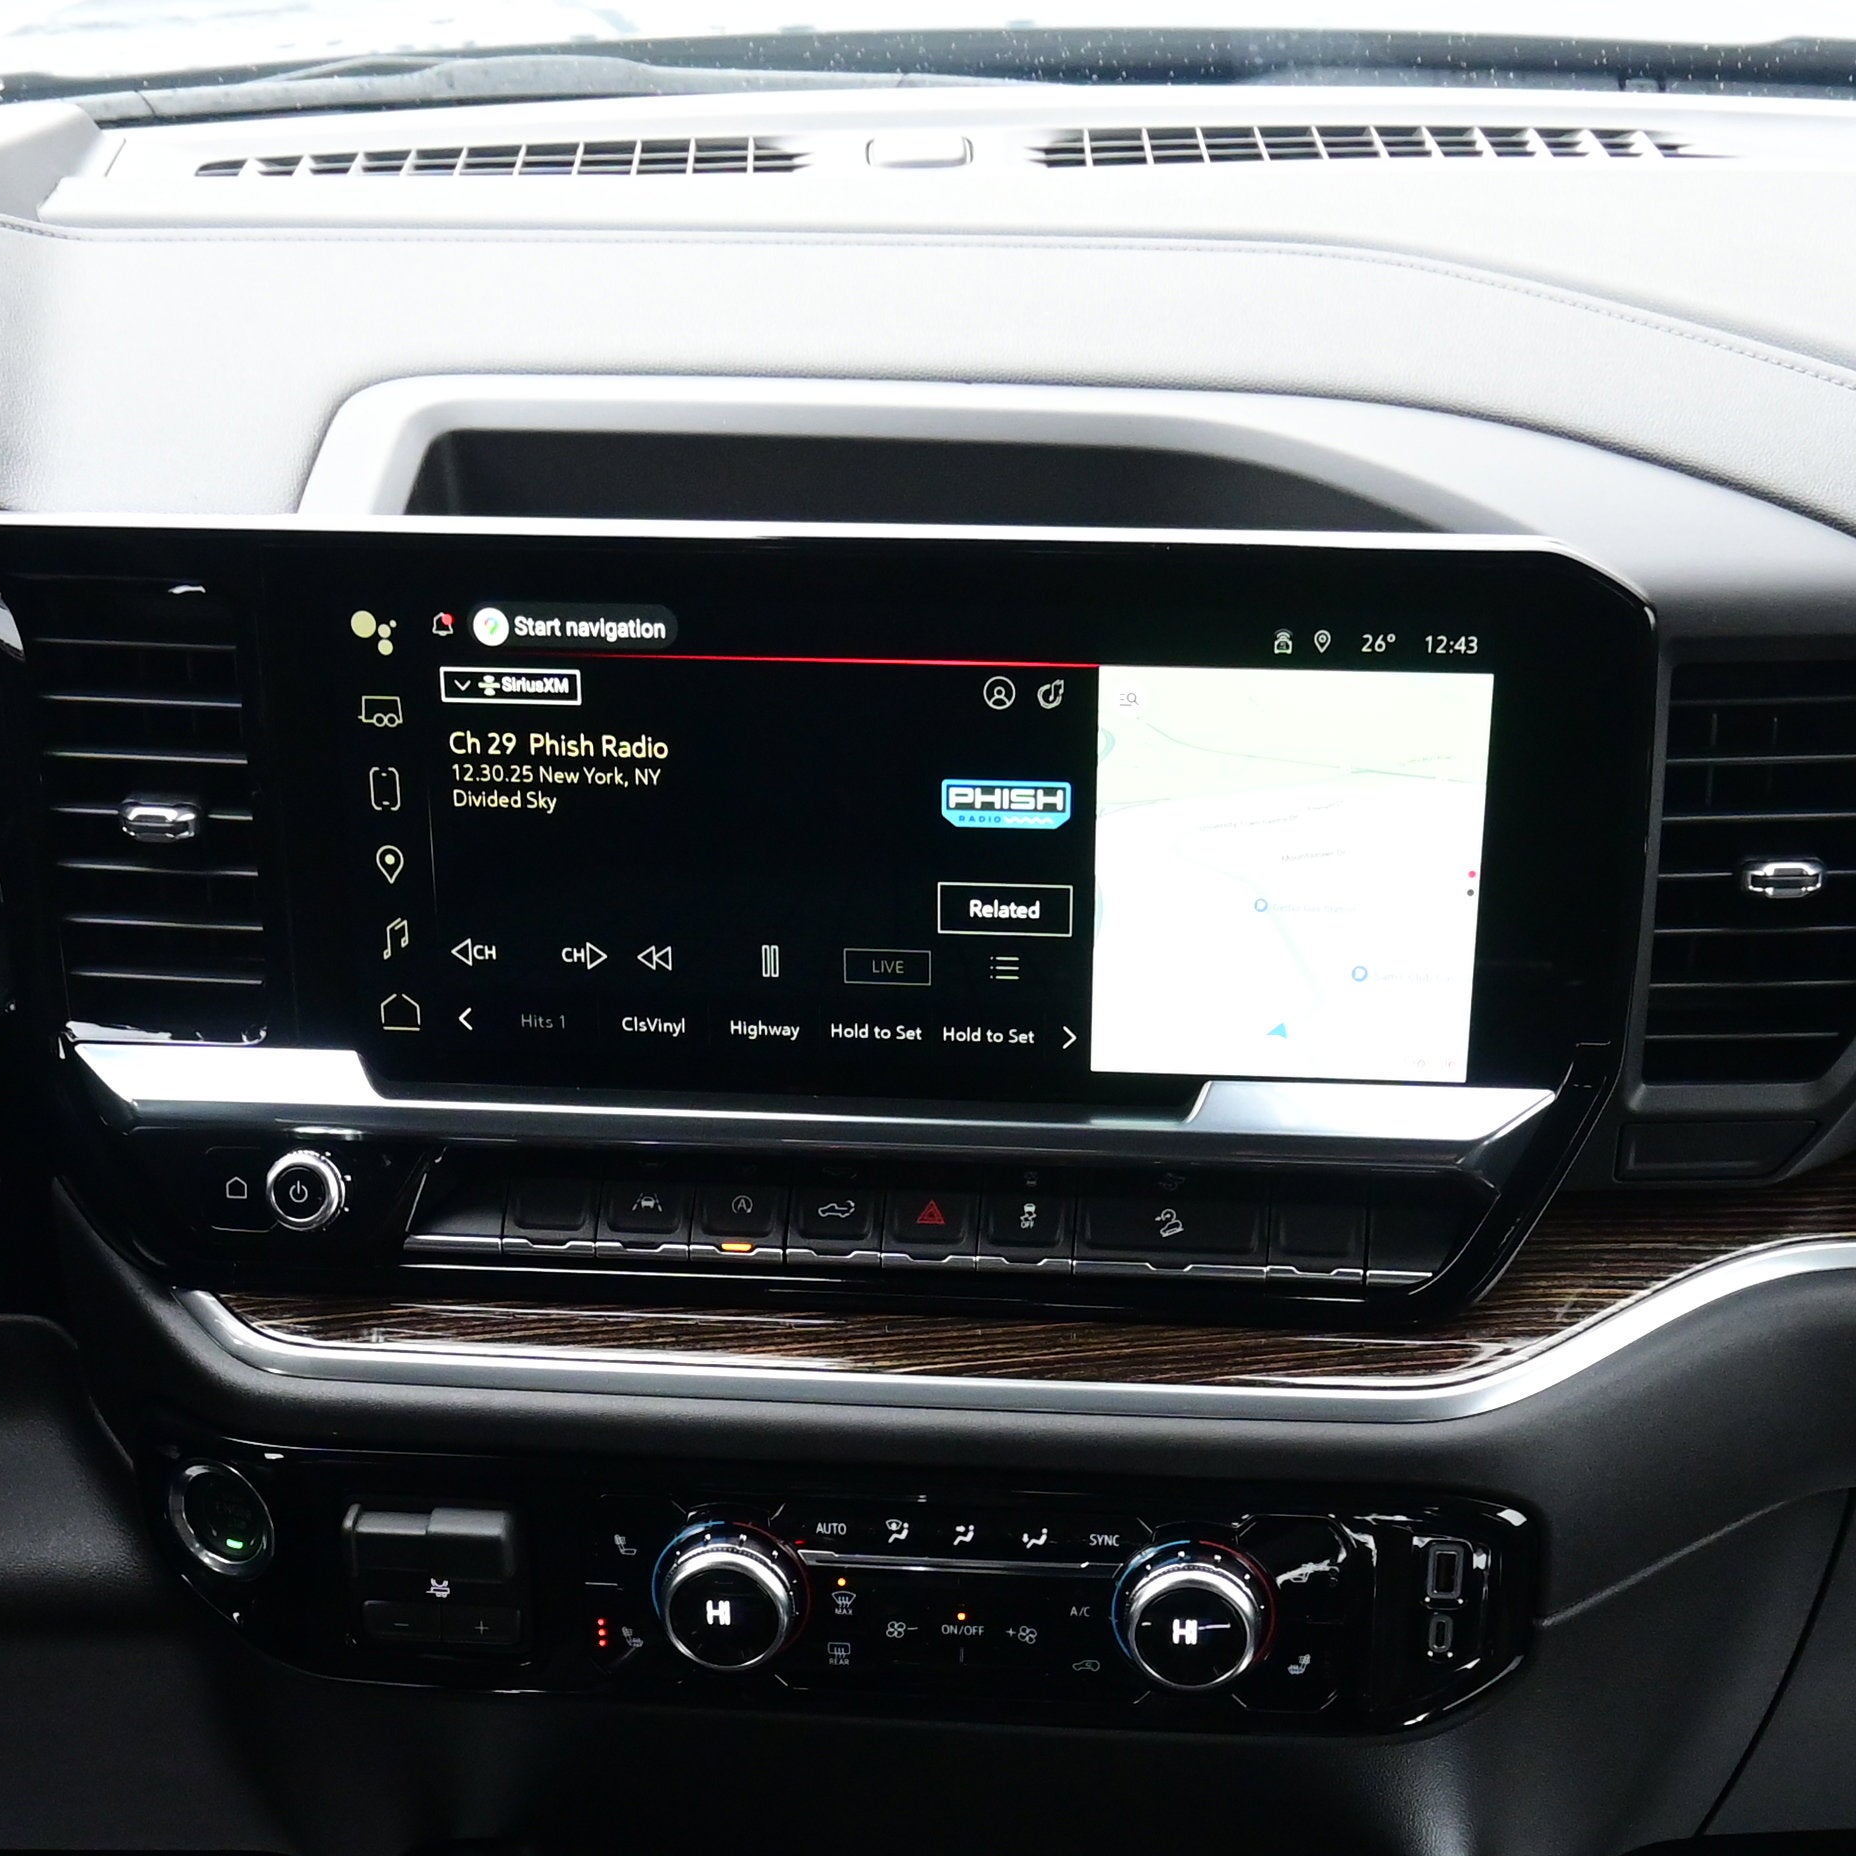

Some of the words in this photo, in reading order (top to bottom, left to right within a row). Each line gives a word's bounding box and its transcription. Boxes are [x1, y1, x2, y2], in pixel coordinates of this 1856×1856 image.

[514, 617, 561, 636] Start
[566, 618, 666, 640] navigation
[1424, 635, 1479, 655] 12:43
[501, 675, 569, 695] SiriusXM
[449, 732, 481, 755] Ch
[486, 733, 517, 756] 29
[529, 734, 594, 758] Phish
[600, 735, 669, 759] Radio
[452, 765, 534, 783] 12.30.25
[538, 767, 578, 785] New
[582, 767, 630, 789] York,
[634, 768, 661, 786] NY
[452, 789, 520, 809] Divided
[525, 790, 557, 814] Sky
[947, 787, 1064, 811] PHISH
[959, 814, 1002, 824] RADIO
[969, 899, 1041, 921] Related
[474, 944, 497, 961] CH
[561, 947, 586, 964] CH
[872, 958, 904, 976] LIVE
[521, 1013, 553, 1030] Hits
[560, 1013, 566, 1030] 1
[622, 1016, 686, 1035] ClsVinyl
[729, 1020, 800, 1042] Highway
[831, 1023, 871, 1041] Hold
[875, 1026, 888, 1041] to
[891, 1025, 923, 1042] Set
[942, 1026, 983, 1044] Hold
[987, 1029, 1001, 1044] to
[1003, 1028, 1035, 1045] Set
[816, 1522, 846, 1536] AUTO
[1089, 1533, 1120, 1548] SYNC
[1070, 1606, 1090, 1617] A/C
[941, 1625, 984, 1636] ON/OFF
